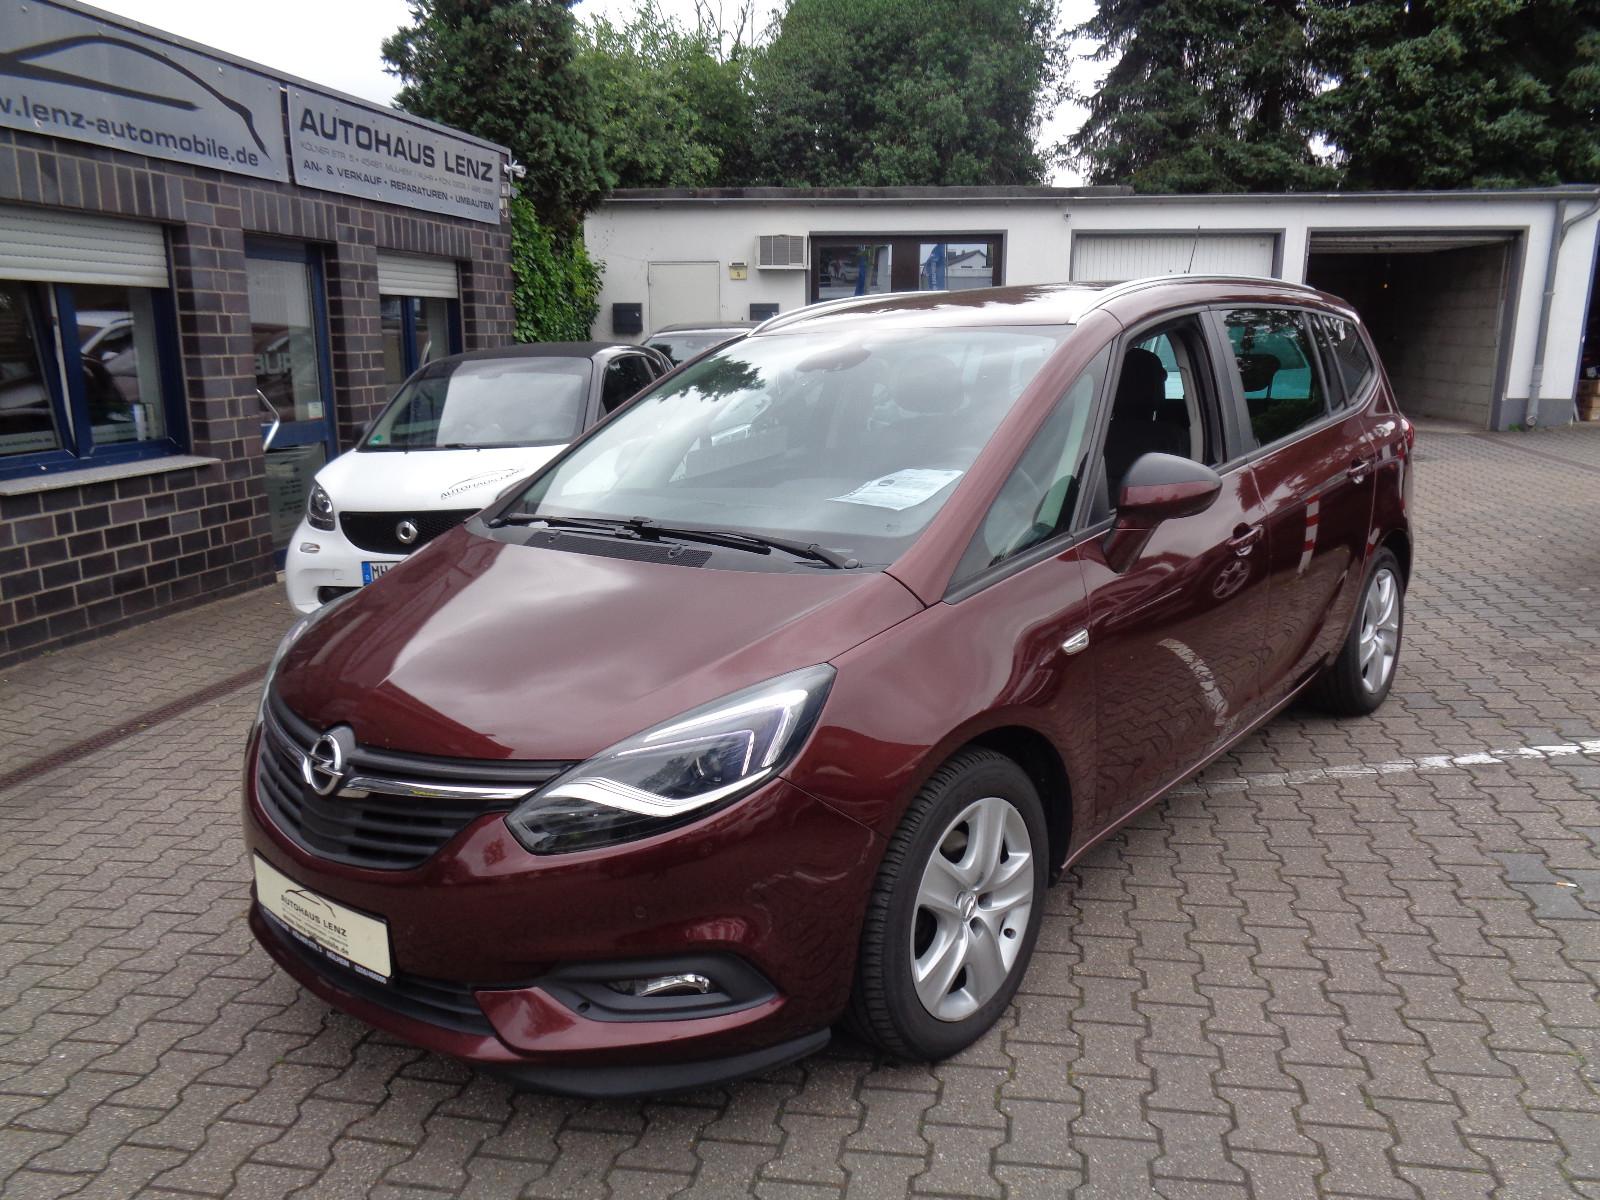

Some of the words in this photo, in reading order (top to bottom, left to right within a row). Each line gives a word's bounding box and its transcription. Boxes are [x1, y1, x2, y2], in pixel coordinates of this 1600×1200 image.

[299, 108, 436, 169] AUTOHAUS
[444, 150, 494, 183] LENZ
[303, 159, 322, 173] AN-
[326, 164, 335, 175] &
[337, 167, 382, 185] VERKAUF
[390, 179, 448, 201] REPARATUREN
[455, 195, 494, 211] UMBAUTEN
[281, 894, 320, 924] AUTOHAUS
[323, 919, 348, 938] LENZ
